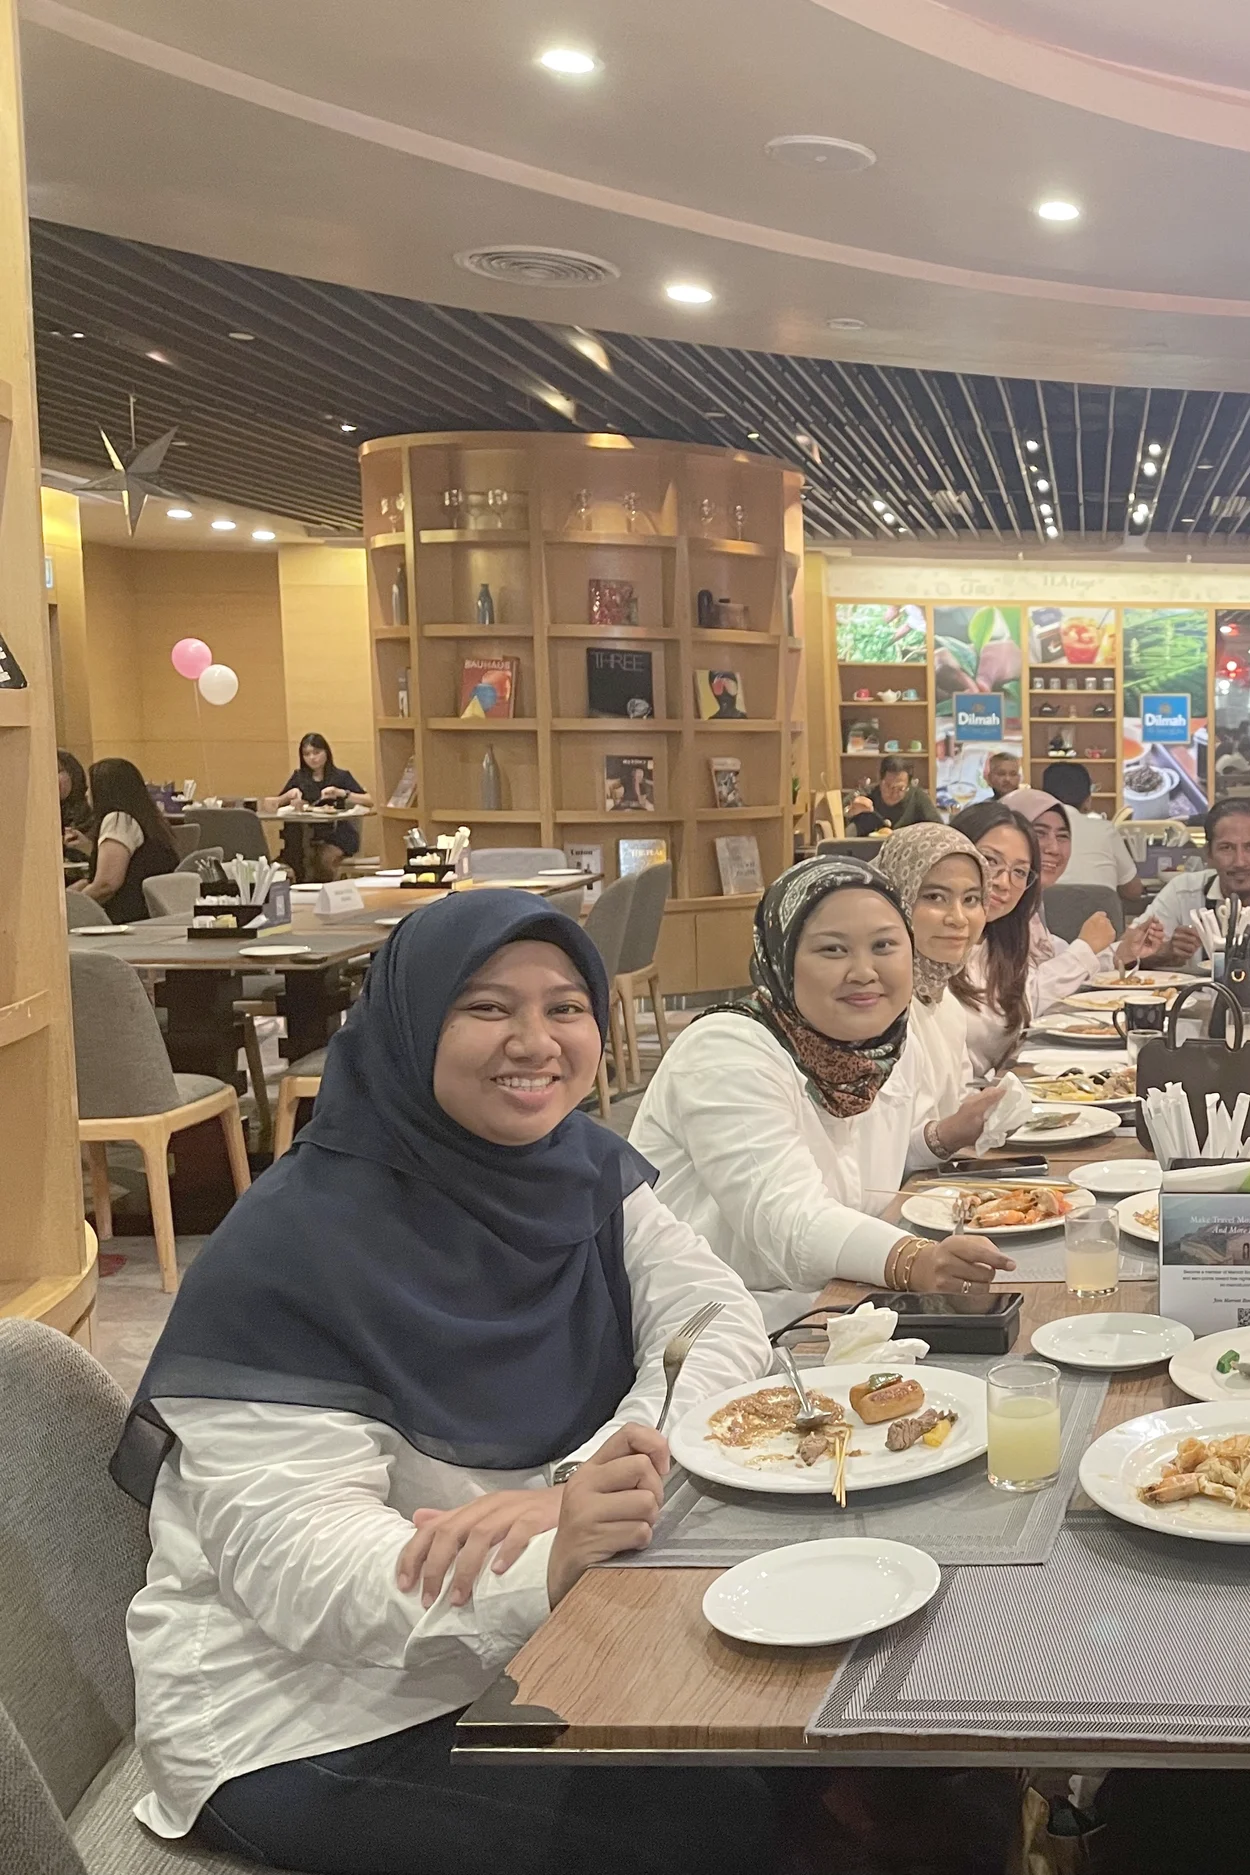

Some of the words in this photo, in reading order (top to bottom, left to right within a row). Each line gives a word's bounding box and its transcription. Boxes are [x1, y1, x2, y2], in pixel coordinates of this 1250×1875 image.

[464, 659, 511, 670] BAUHAUS
[594, 651, 644, 671] THREE
[958, 711, 1000, 725] Dilmah
[1144, 713, 1187, 726] Dilmah
[1190, 1215, 1210, 1224] Make
[1211, 1215, 1235, 1224] Travel
[1211, 1225, 1228, 1234] And
[1228, 1225, 1249, 1234] More
